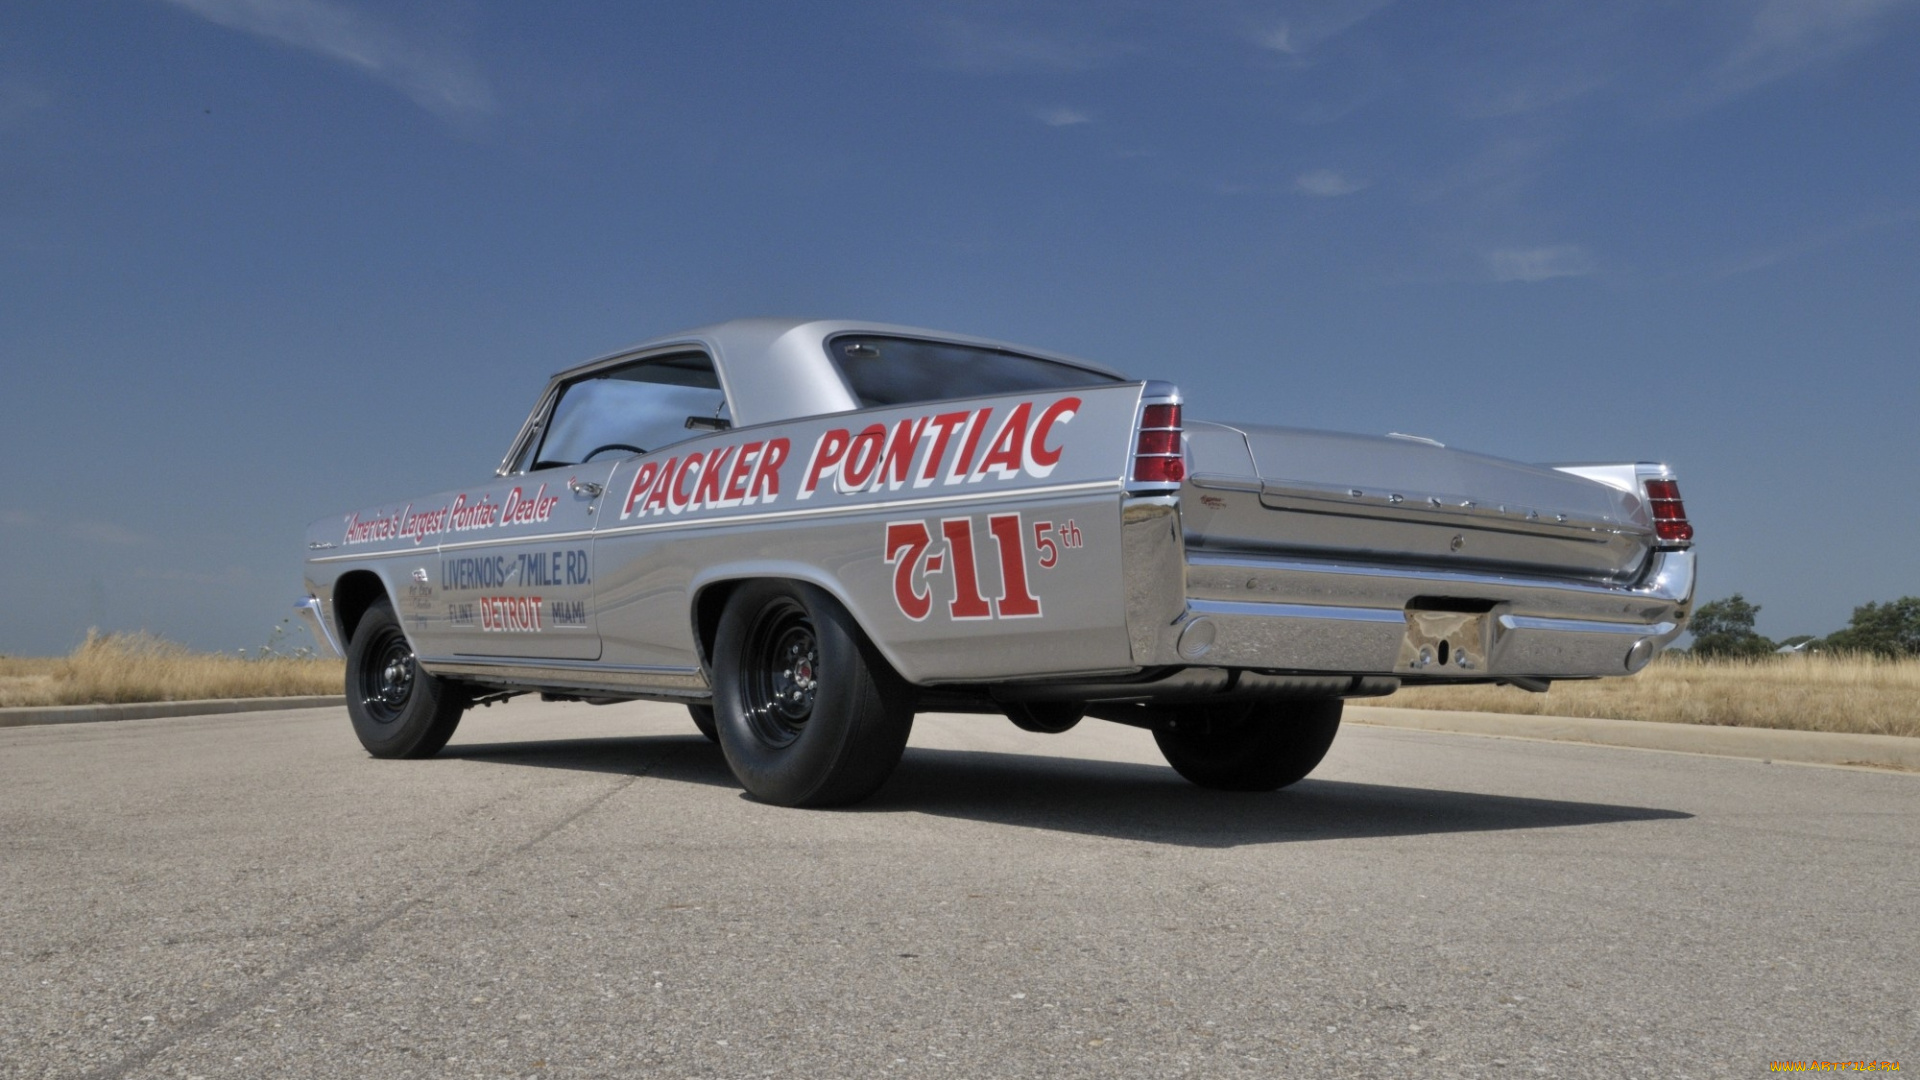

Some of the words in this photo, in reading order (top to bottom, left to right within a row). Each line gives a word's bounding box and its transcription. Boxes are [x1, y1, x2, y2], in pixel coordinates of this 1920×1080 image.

[620, 437, 790, 520] PACKER
[797, 397, 1082, 500] PONTIAC
[398, 503, 447, 545] Largest
[446, 494, 498, 533] Pontiac
[499, 483, 558, 527] Dealer
[442, 555, 505, 591] LIVERNOIS
[566, 549, 591, 585] RD.
[884, 512, 1043, 622] 7-11
[1033, 519, 1083, 569] 5th
[449, 603, 474, 624] FLINT
[480, 596, 543, 632] DETROIT
[552, 601, 586, 624] MIAMI
